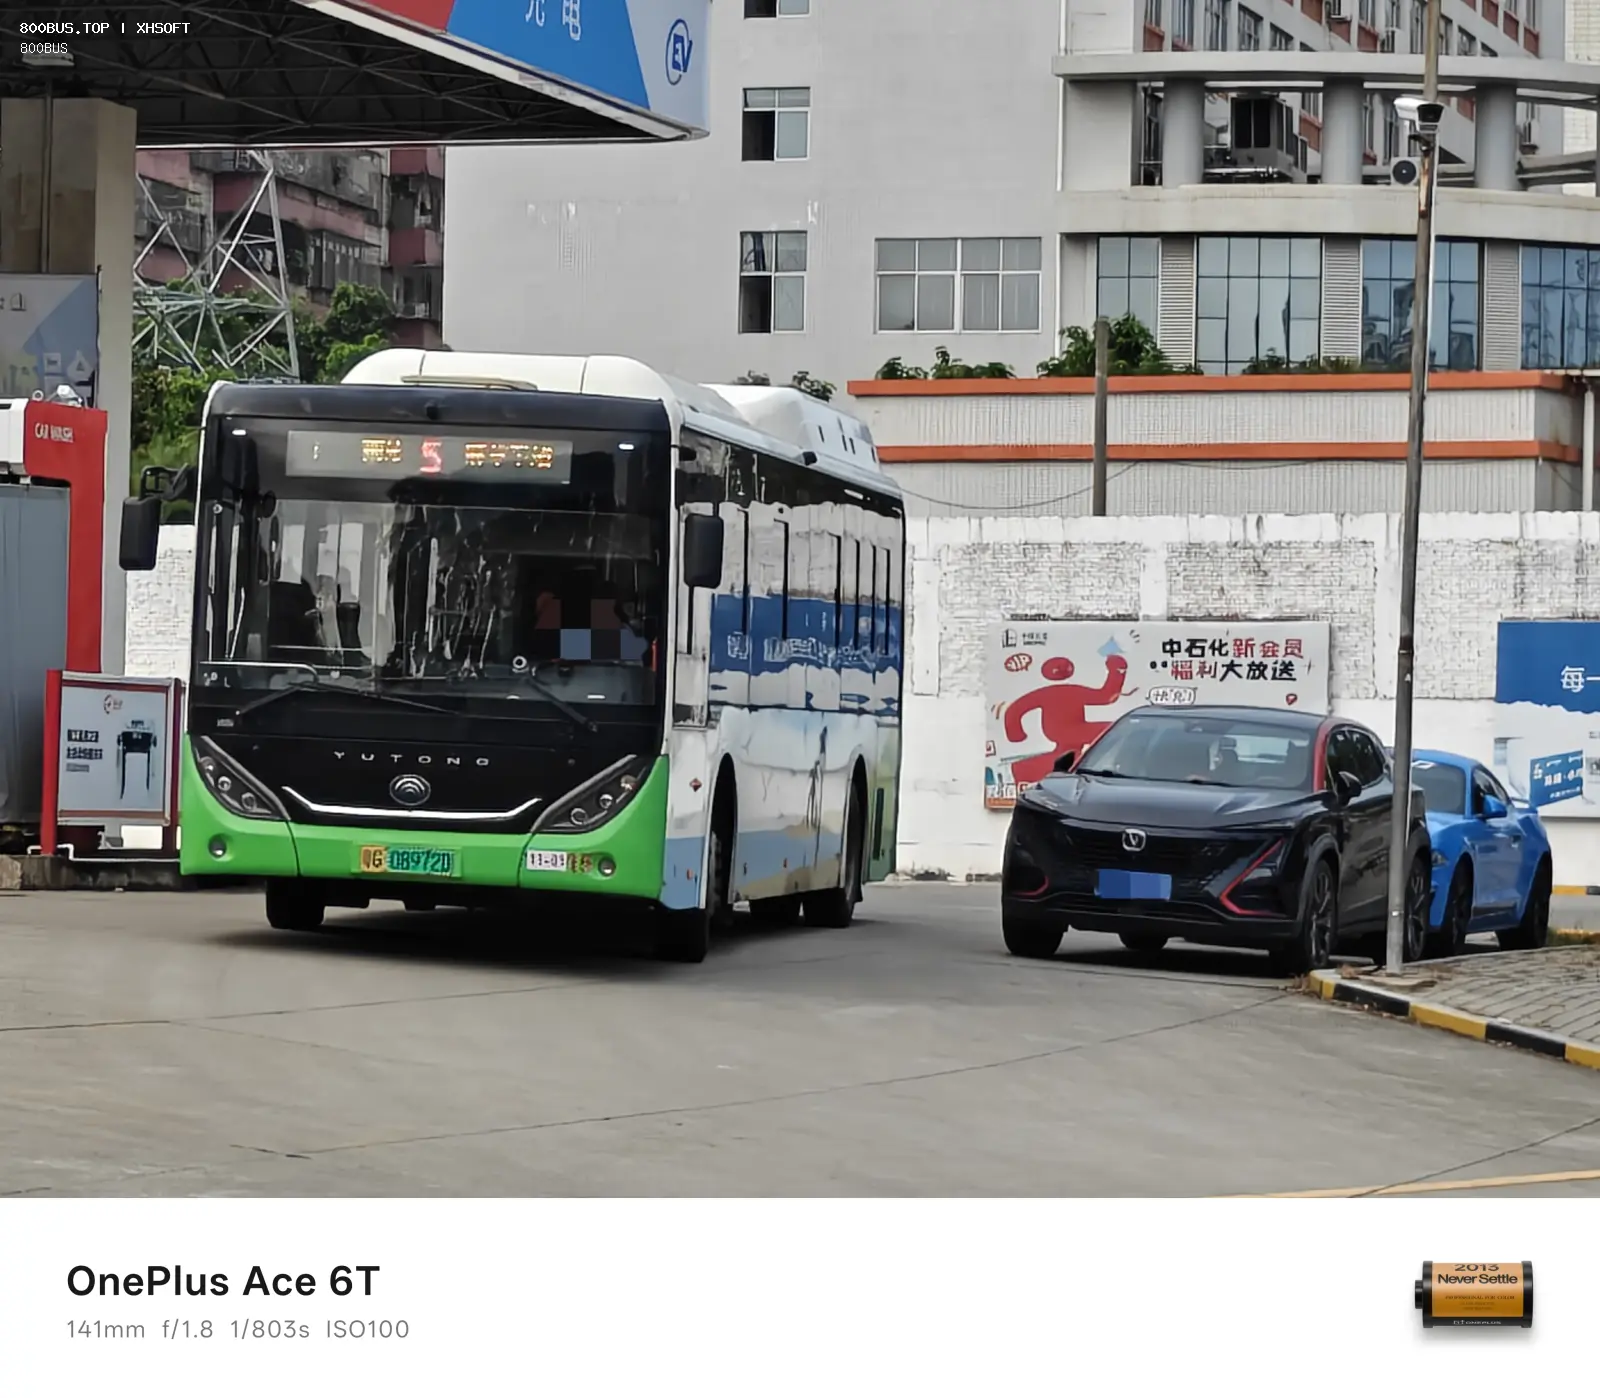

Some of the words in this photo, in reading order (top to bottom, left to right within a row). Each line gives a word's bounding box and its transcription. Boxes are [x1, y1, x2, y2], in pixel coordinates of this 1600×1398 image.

[1162, 637, 1304, 659] 中石化新会员
[1171, 659, 1297, 682] 福利大放送
[334, 751, 489, 766] YUTONG
